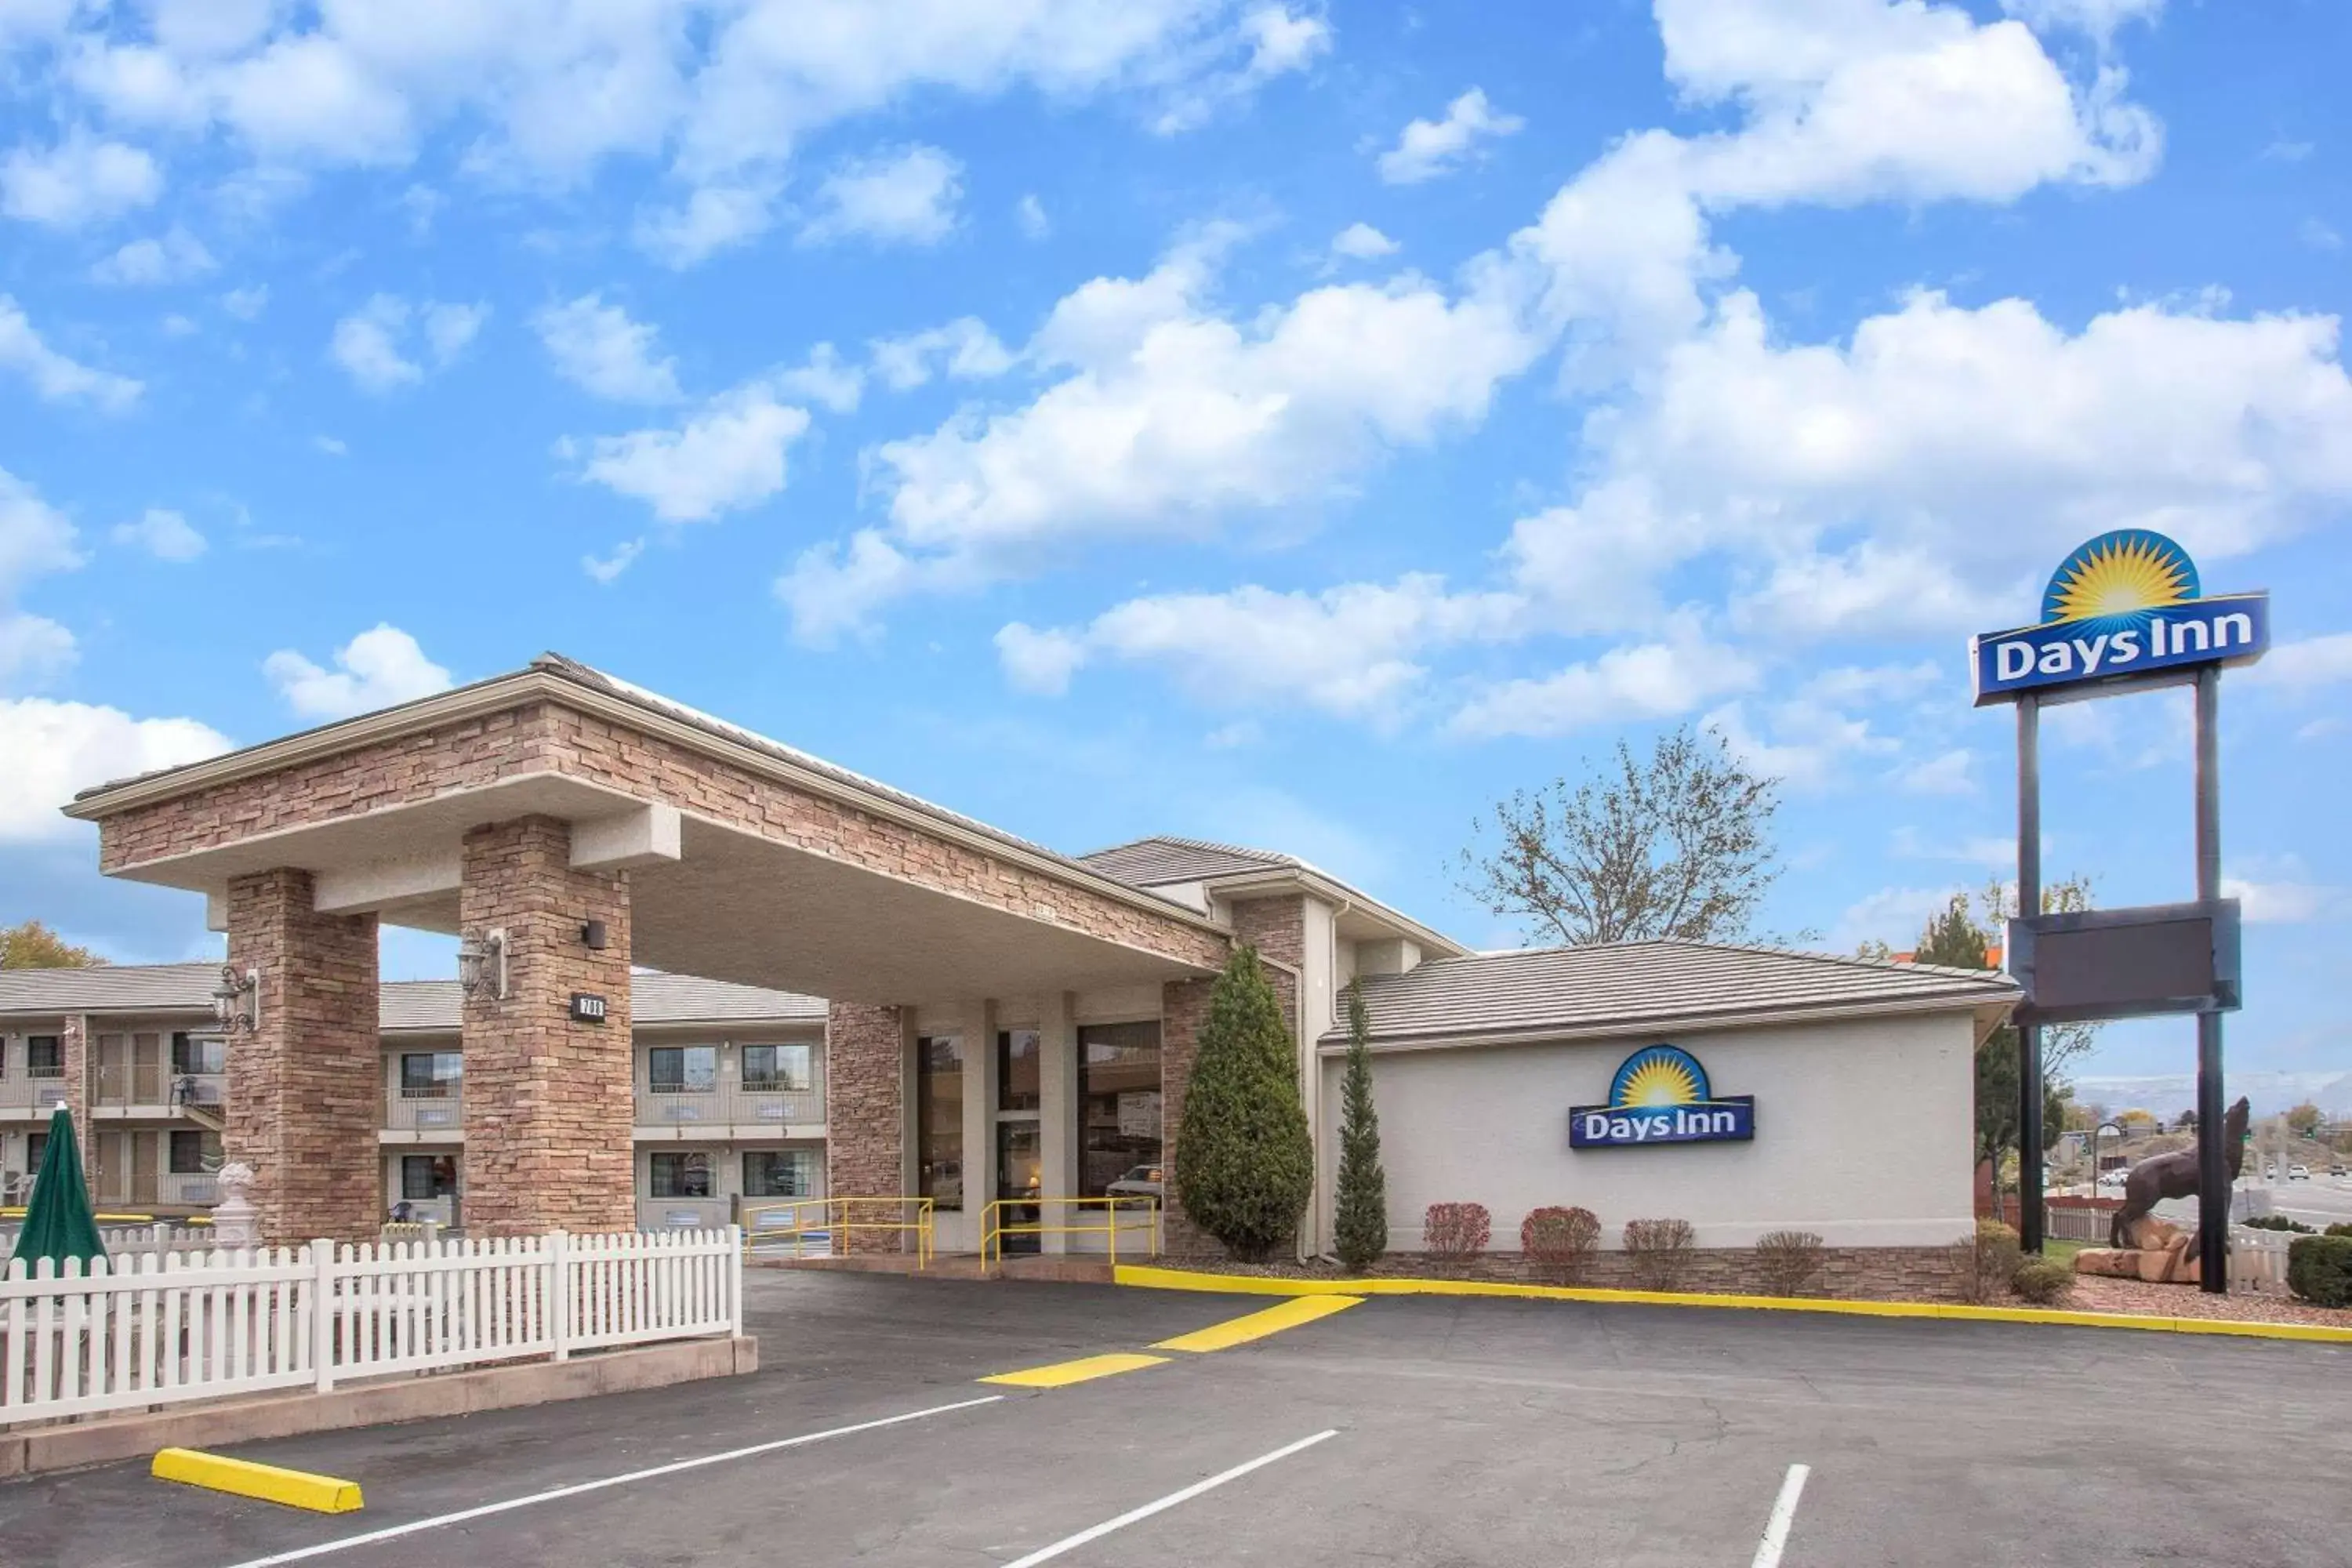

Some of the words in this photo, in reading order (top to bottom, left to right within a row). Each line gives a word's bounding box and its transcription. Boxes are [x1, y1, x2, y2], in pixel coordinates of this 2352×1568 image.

[1997, 630, 2139, 681] Days
[2151, 613, 2252, 657] Inn
[1585, 1115, 1670, 1140] Days
[1677, 1109, 1735, 1134] Inn
